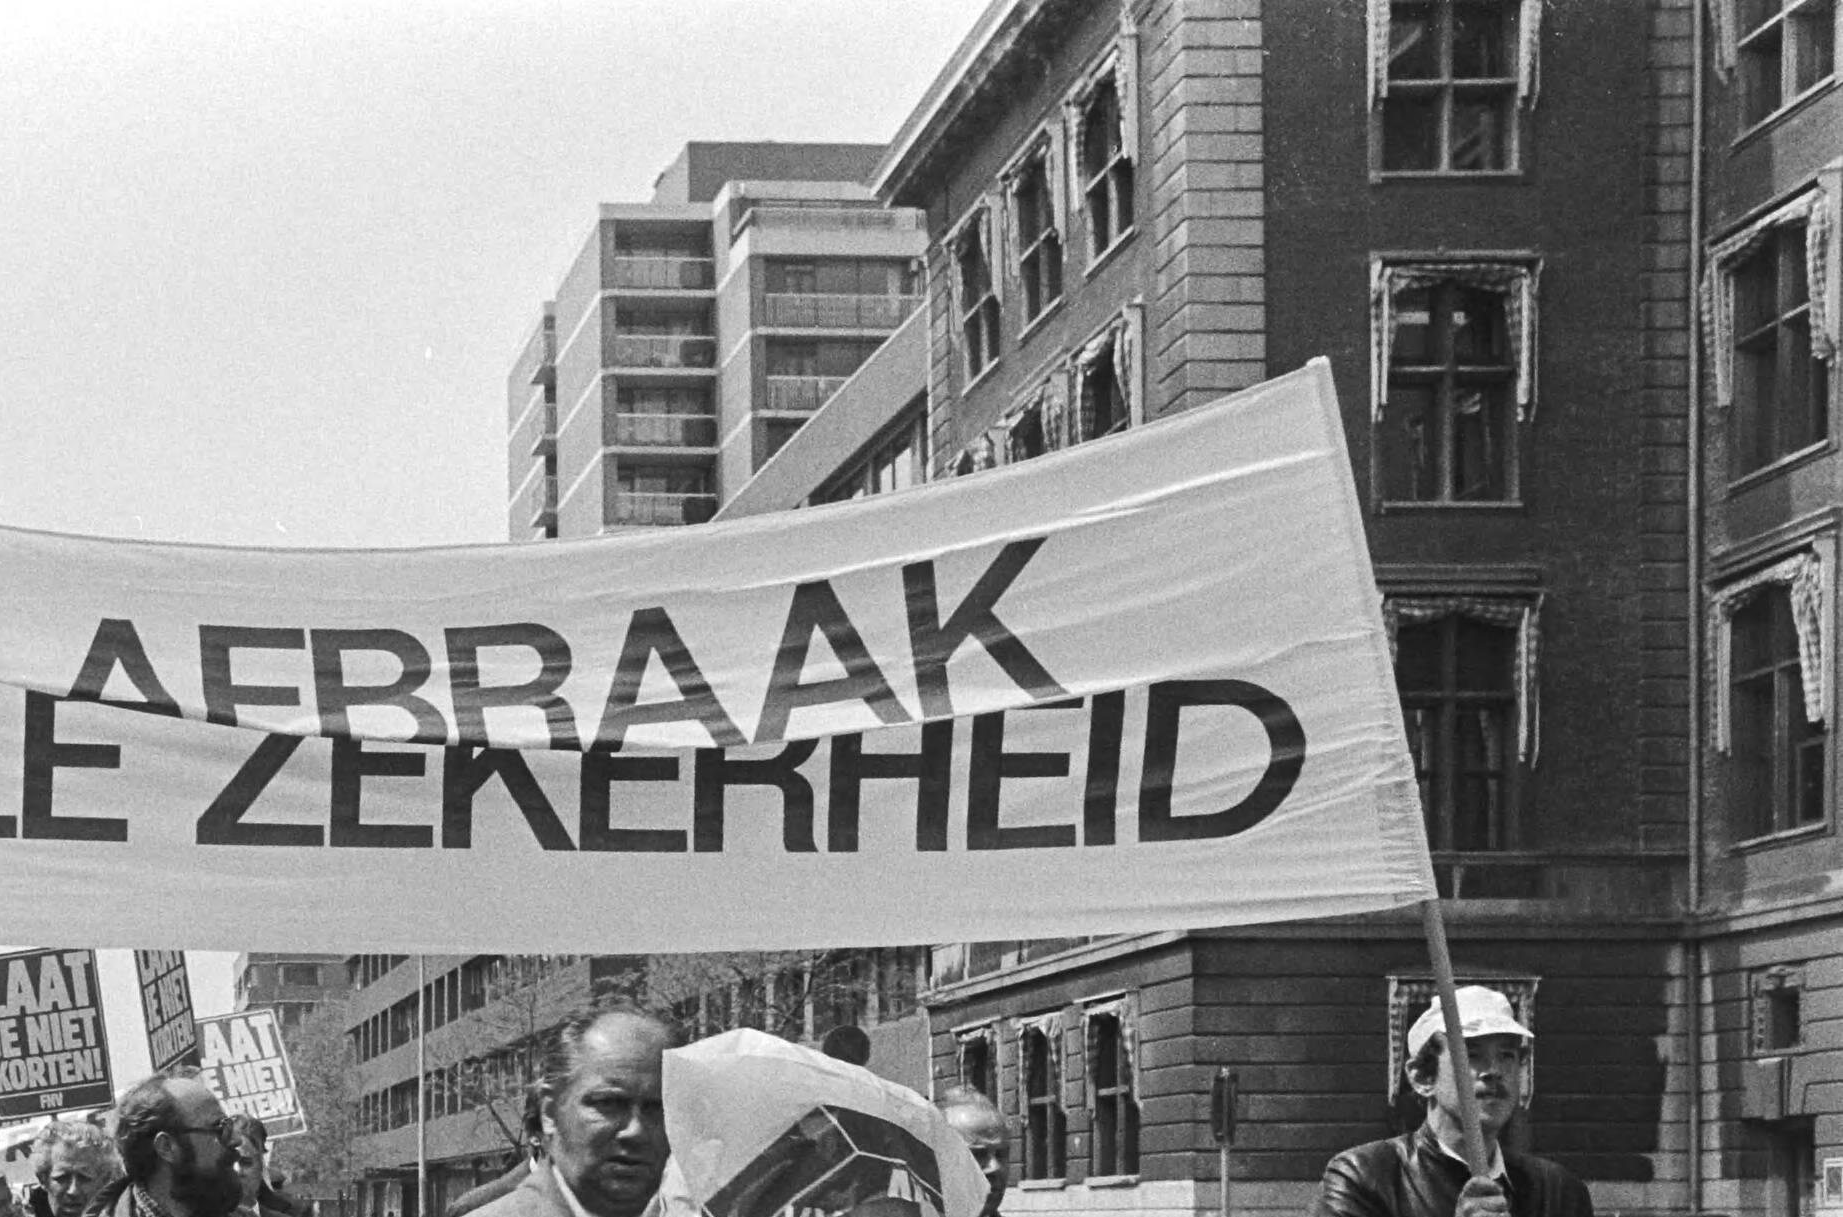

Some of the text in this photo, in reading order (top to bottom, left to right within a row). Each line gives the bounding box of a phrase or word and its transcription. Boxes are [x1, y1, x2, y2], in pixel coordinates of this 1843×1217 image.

[68, 536, 1072, 751] AFBRAAK
[195, 678, 1308, 854] ZEKERHEID
[144, 966, 189, 1033] JE NIET
[25, 1007, 97, 1056] NIET
[151, 1010, 195, 1069] KORTEN!
[201, 1013, 277, 1068] AAT
[40, 1091, 63, 1109] FNV
[201, 1056, 286, 1100] E NIET
[219, 1086, 296, 1119] RTEN!
